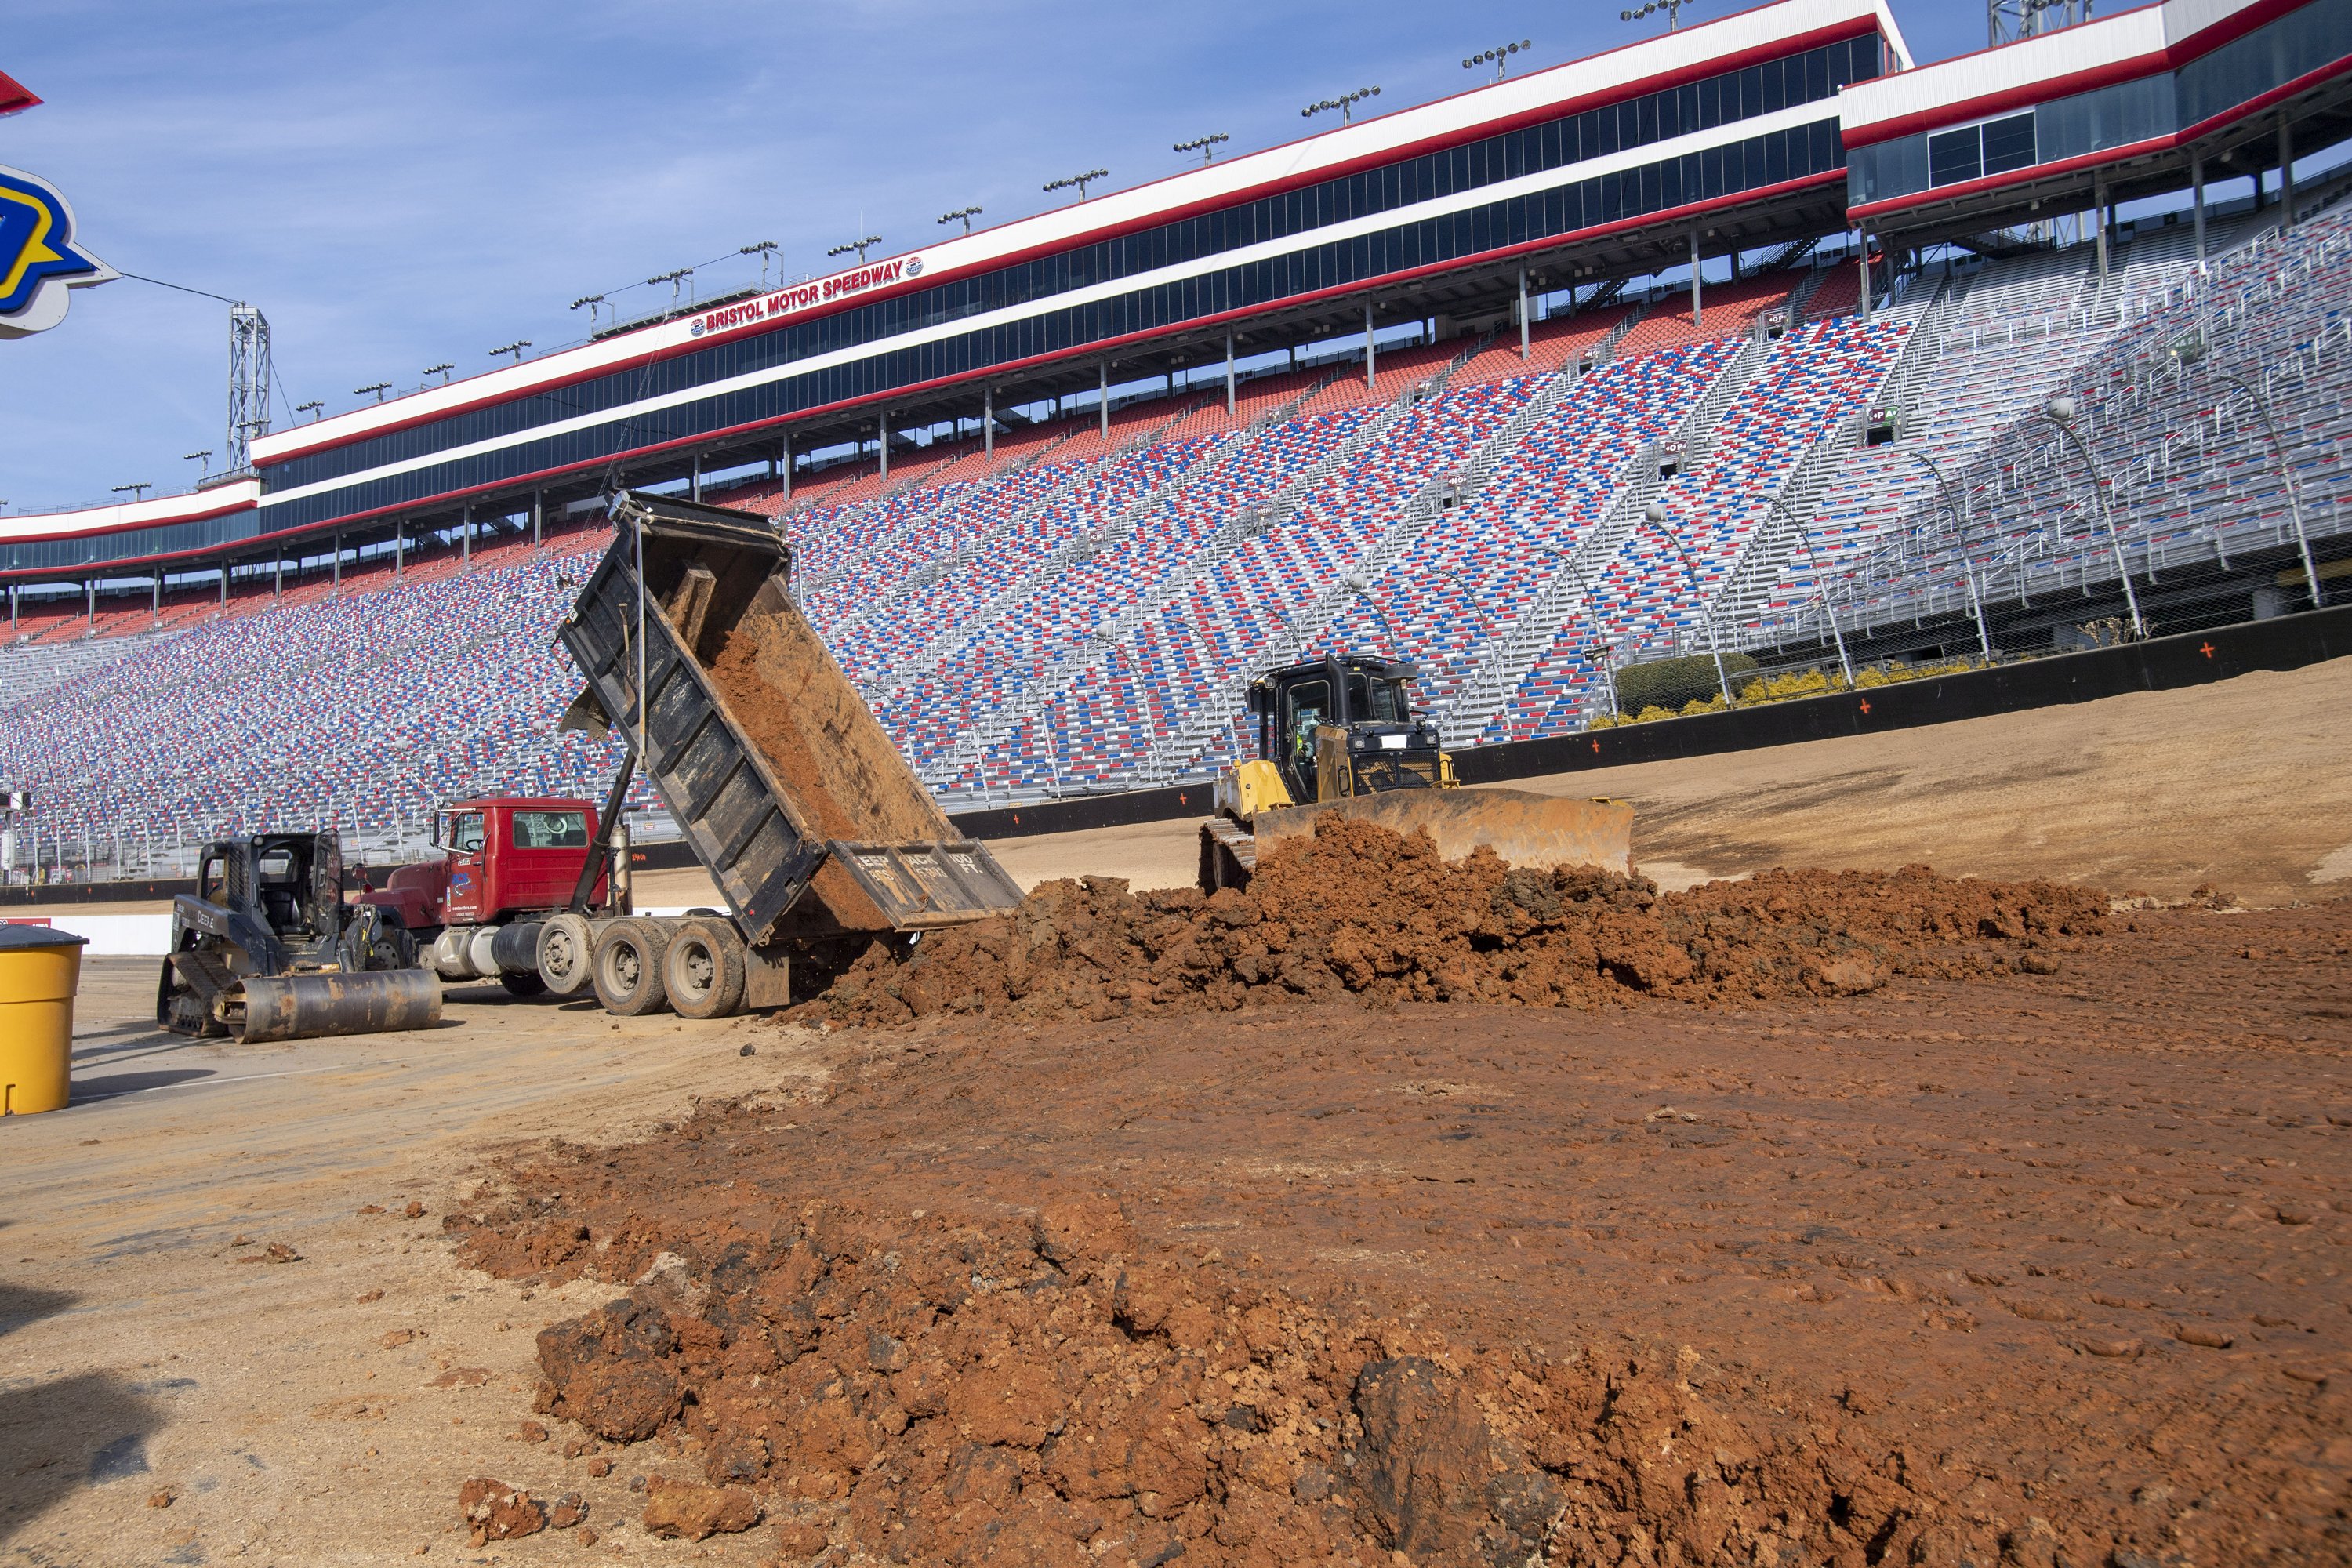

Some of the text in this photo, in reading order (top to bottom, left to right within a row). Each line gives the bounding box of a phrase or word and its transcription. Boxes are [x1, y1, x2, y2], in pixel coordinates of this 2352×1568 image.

[706, 260, 902, 330] BRISTOL MOTOR SPEEDWAY
[853, 853, 973, 868] EEP ACK 100
[959, 864, 984, 874] FT.
[452, 873, 469, 884] BCS
